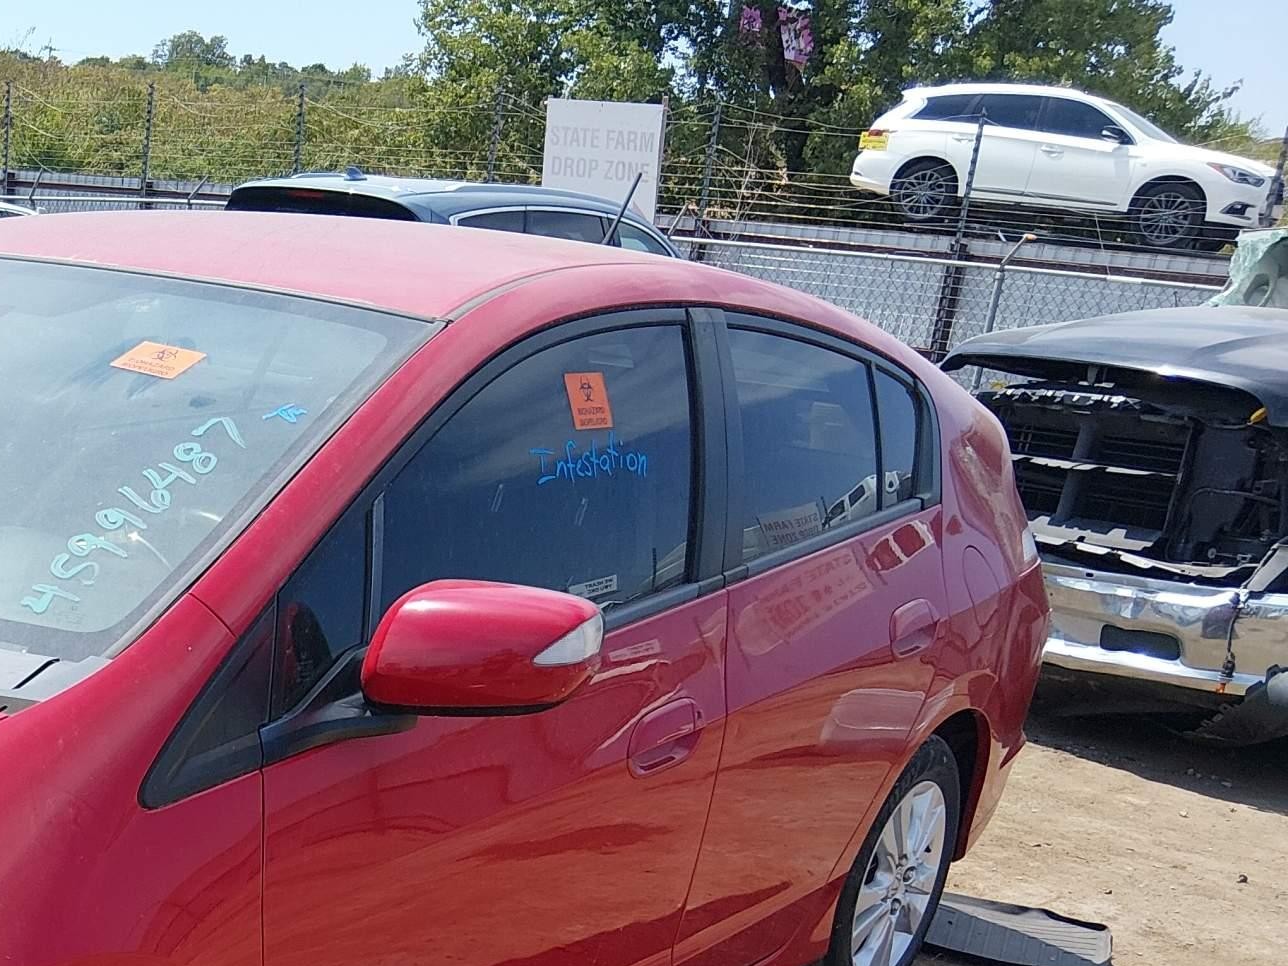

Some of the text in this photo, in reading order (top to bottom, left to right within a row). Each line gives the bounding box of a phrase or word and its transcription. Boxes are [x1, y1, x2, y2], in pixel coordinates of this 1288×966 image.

[550, 126, 655, 153] STATE FARM
[551, 156, 650, 183] DROP ZONE
[529, 430, 648, 486] Infestation
[20, 416, 246, 614] 45996487
